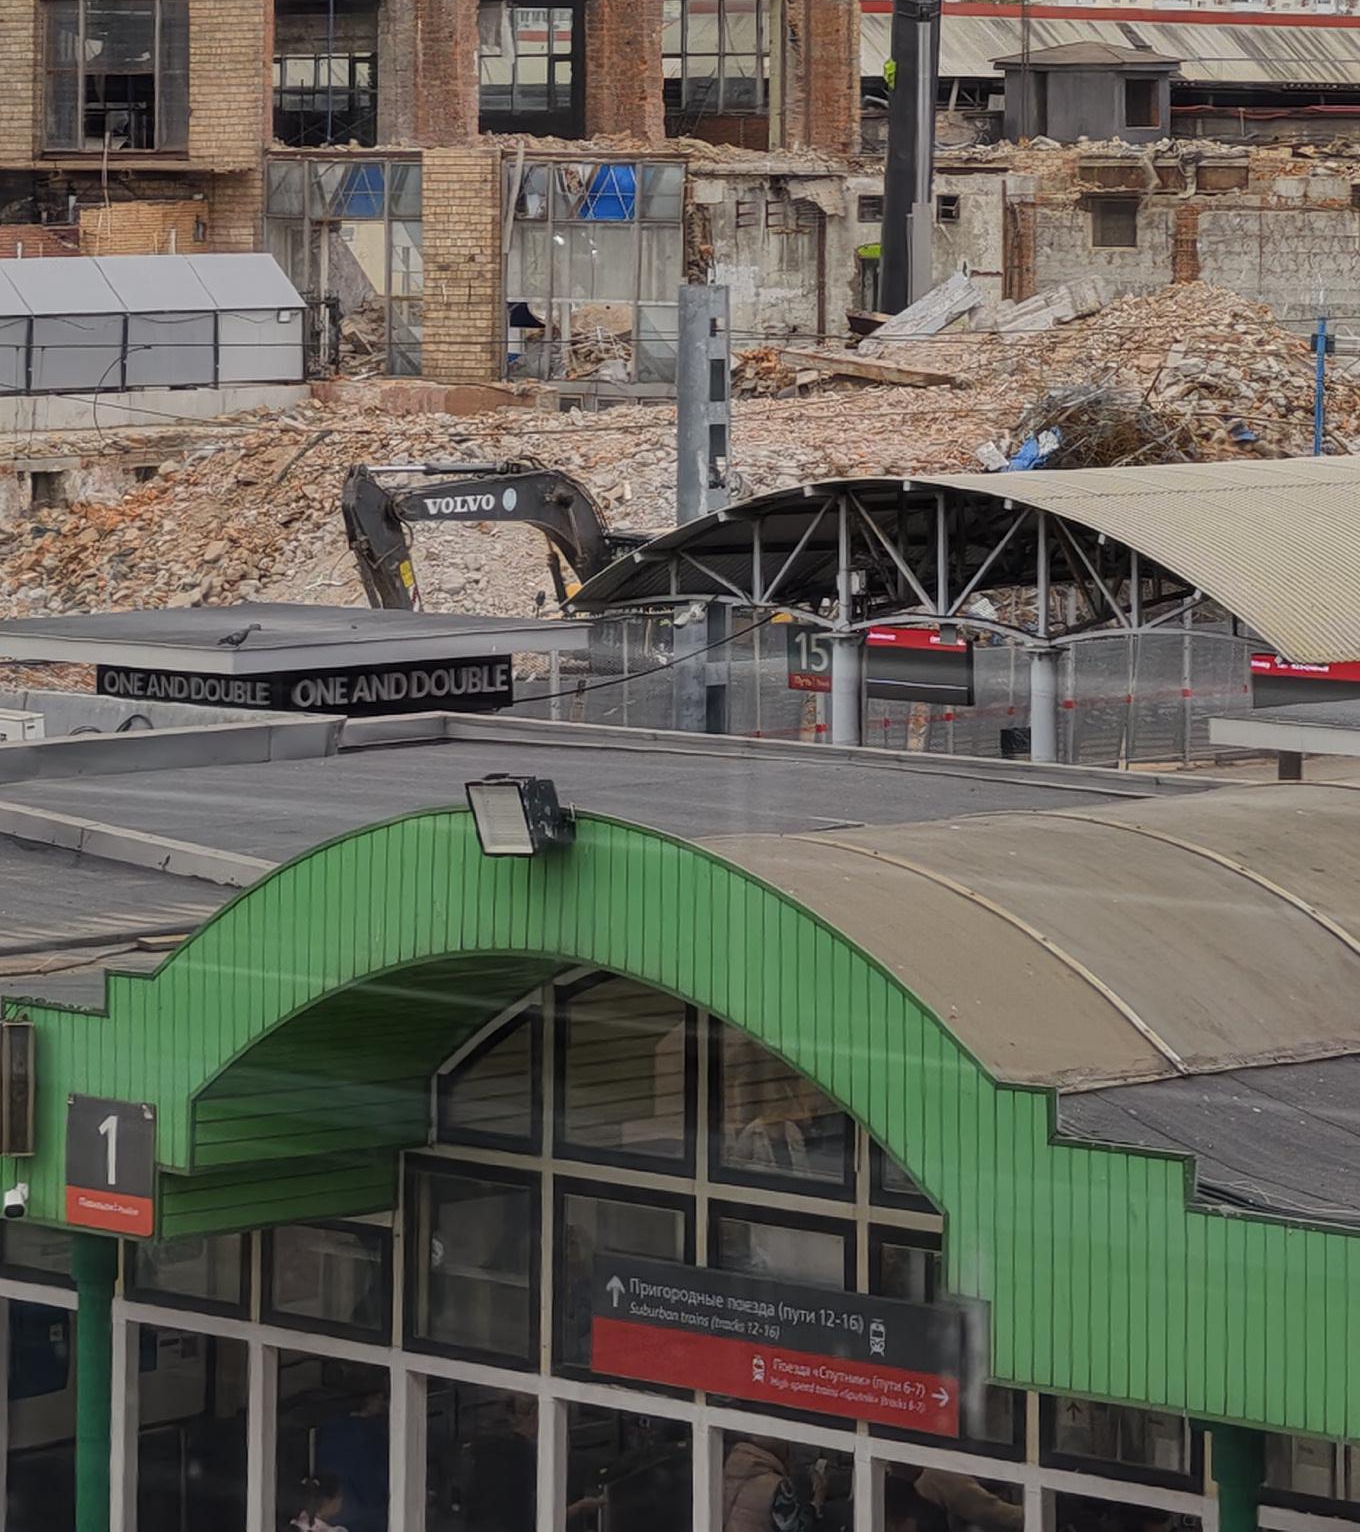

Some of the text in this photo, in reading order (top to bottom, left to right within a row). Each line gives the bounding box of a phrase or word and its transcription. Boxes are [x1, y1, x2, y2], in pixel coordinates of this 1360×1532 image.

[423, 494, 495, 515] VOLVO
[794, 632, 829, 672] 15
[104, 670, 271, 705] ONE AND DOUBLE
[292, 664, 509, 707] ONE AND DOUBLE
[98, 1115, 118, 1185] 1
[629, 1277, 864, 1334] Пригородные поезда (пути 12-16)
[629, 1302, 680, 1321] Suburban
[680, 1311, 709, 1327] trains
[747, 1321, 780, 1339] 12-16)
